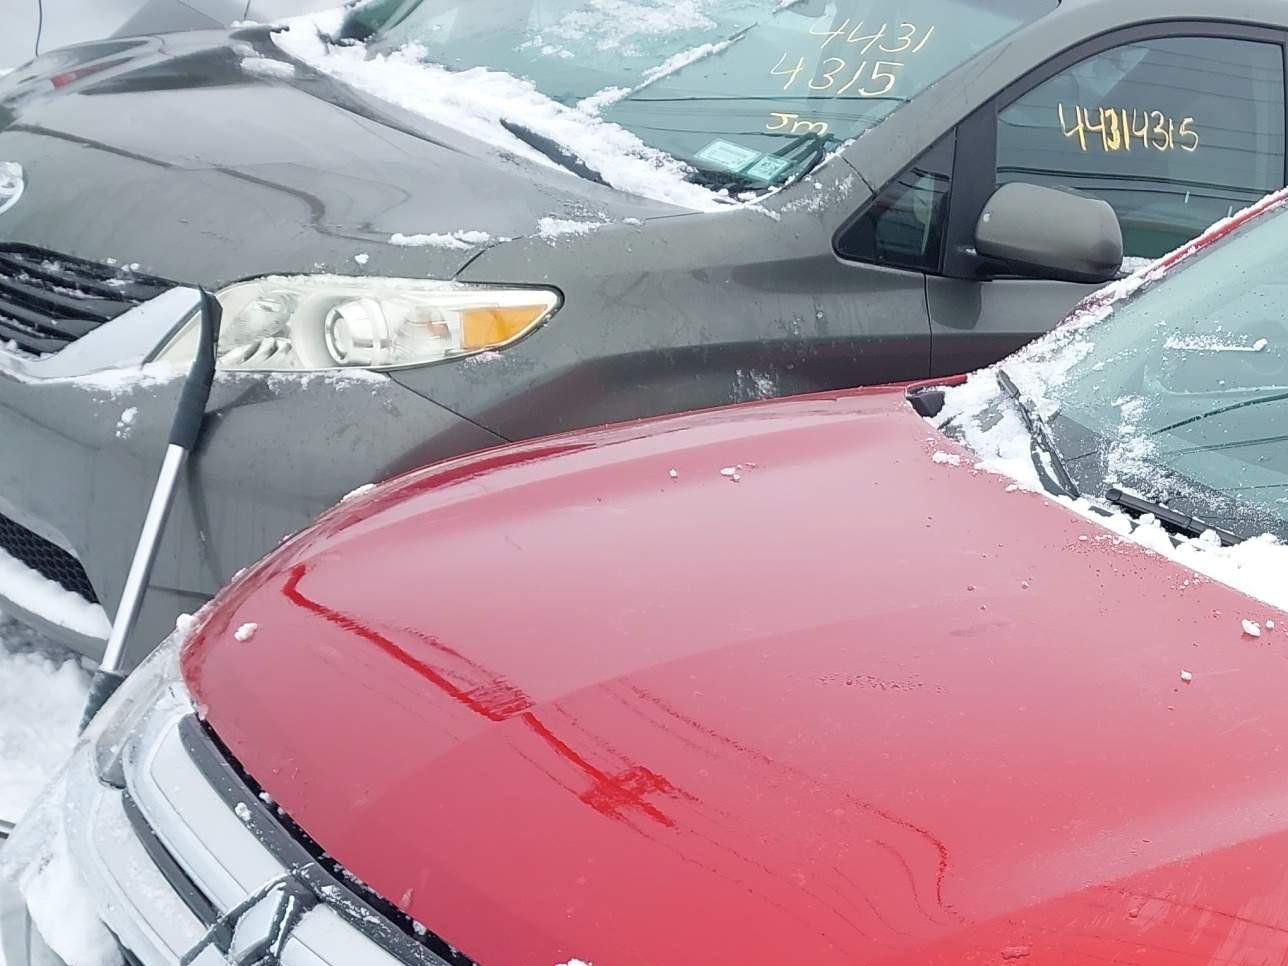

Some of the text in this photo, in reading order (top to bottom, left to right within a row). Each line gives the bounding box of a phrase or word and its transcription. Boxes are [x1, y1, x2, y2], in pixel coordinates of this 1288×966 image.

[808, 17, 936, 55] 4431
[769, 52, 905, 96] 4315
[1058, 102, 1200, 152] 44314315
